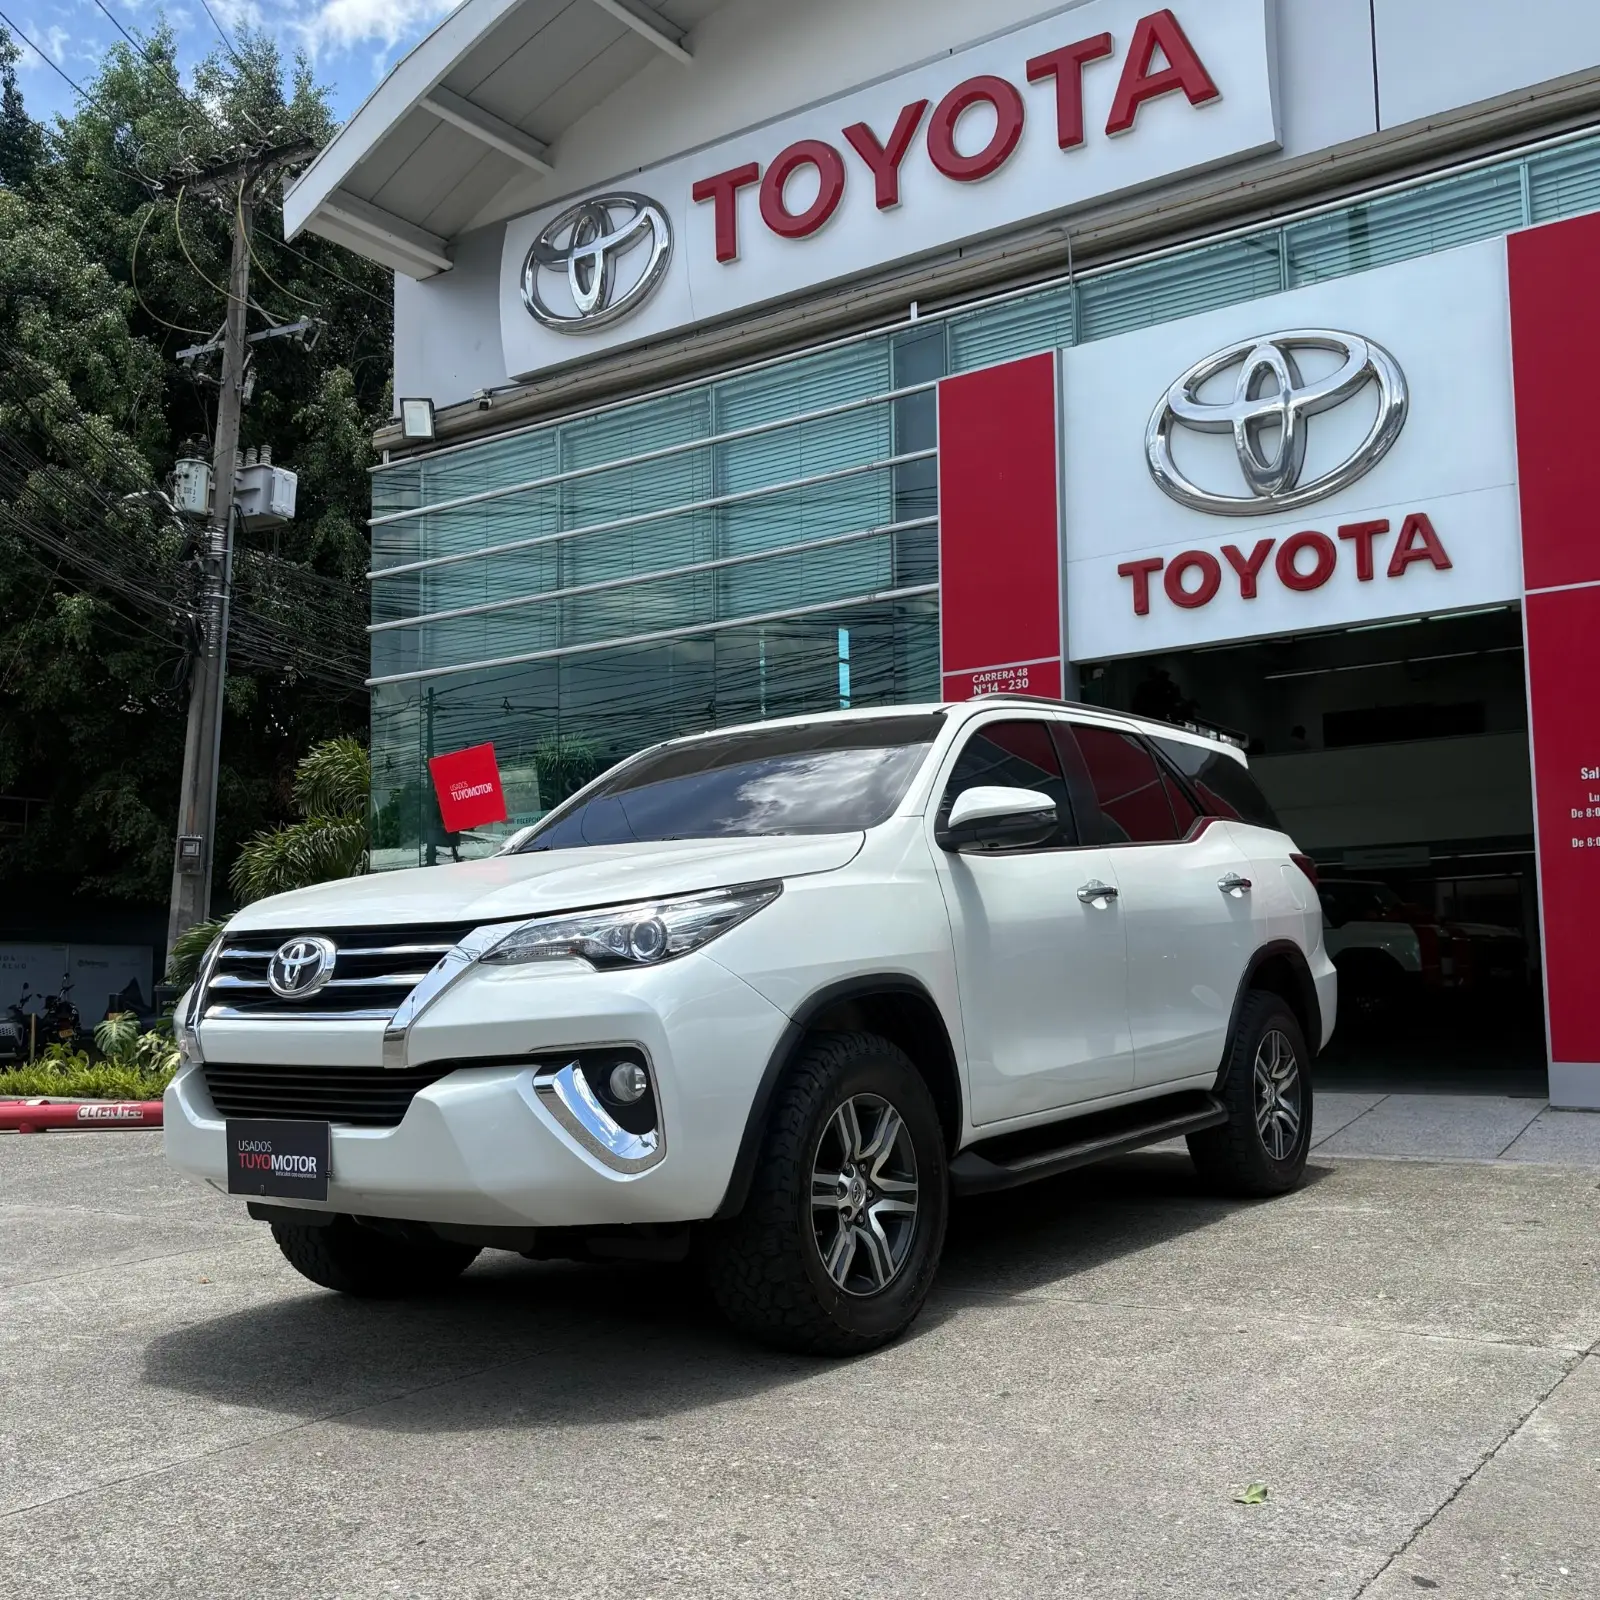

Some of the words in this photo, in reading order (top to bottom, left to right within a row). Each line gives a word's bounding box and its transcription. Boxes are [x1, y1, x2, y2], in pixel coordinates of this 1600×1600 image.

[692, 8, 1222, 264] TOYOTA
[1118, 512, 1453, 616] TOYOTA
[972, 670, 1015, 684] CARRERA
[1017, 667, 1029, 677] 48
[1008, 678, 1029, 690] 230
[449, 780, 469, 792] USADOS
[451, 782, 494, 802] TUYOMOTOR
[1571, 808, 1584, 818] De
[1572, 838, 1585, 848] De
[238, 1140, 272, 1152] USADOS
[239, 1153, 317, 1172] TUYOMOTOR
